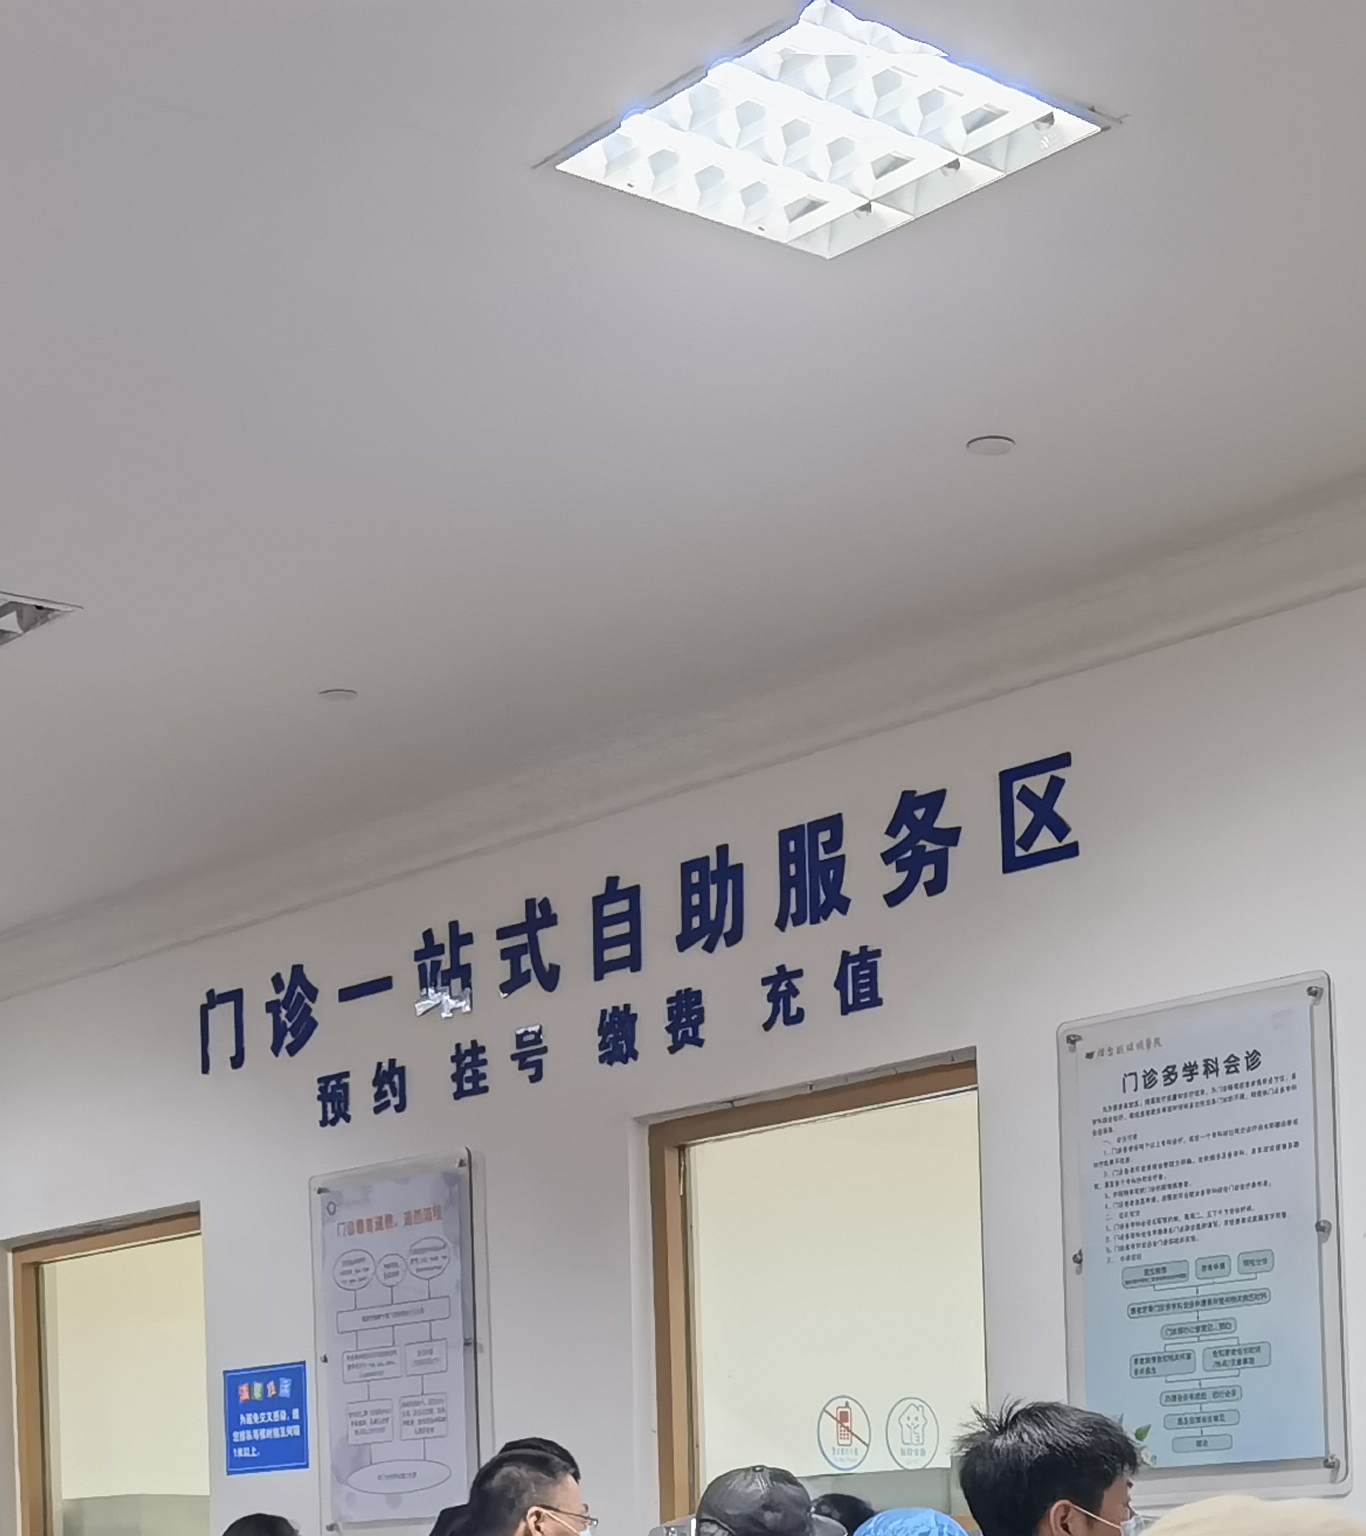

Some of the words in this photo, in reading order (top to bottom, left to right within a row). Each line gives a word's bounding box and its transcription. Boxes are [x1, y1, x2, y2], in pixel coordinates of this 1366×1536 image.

[197, 751, 1081, 1076] 门诊一站式自助服务区
[316, 1056, 409, 1128] 预约
[449, 1023, 550, 1101] 挂号
[595, 986, 707, 1067] 缴费
[760, 944, 885, 1031] 充值
[1121, 1048, 1263, 1095] 门诊多学科会诊
